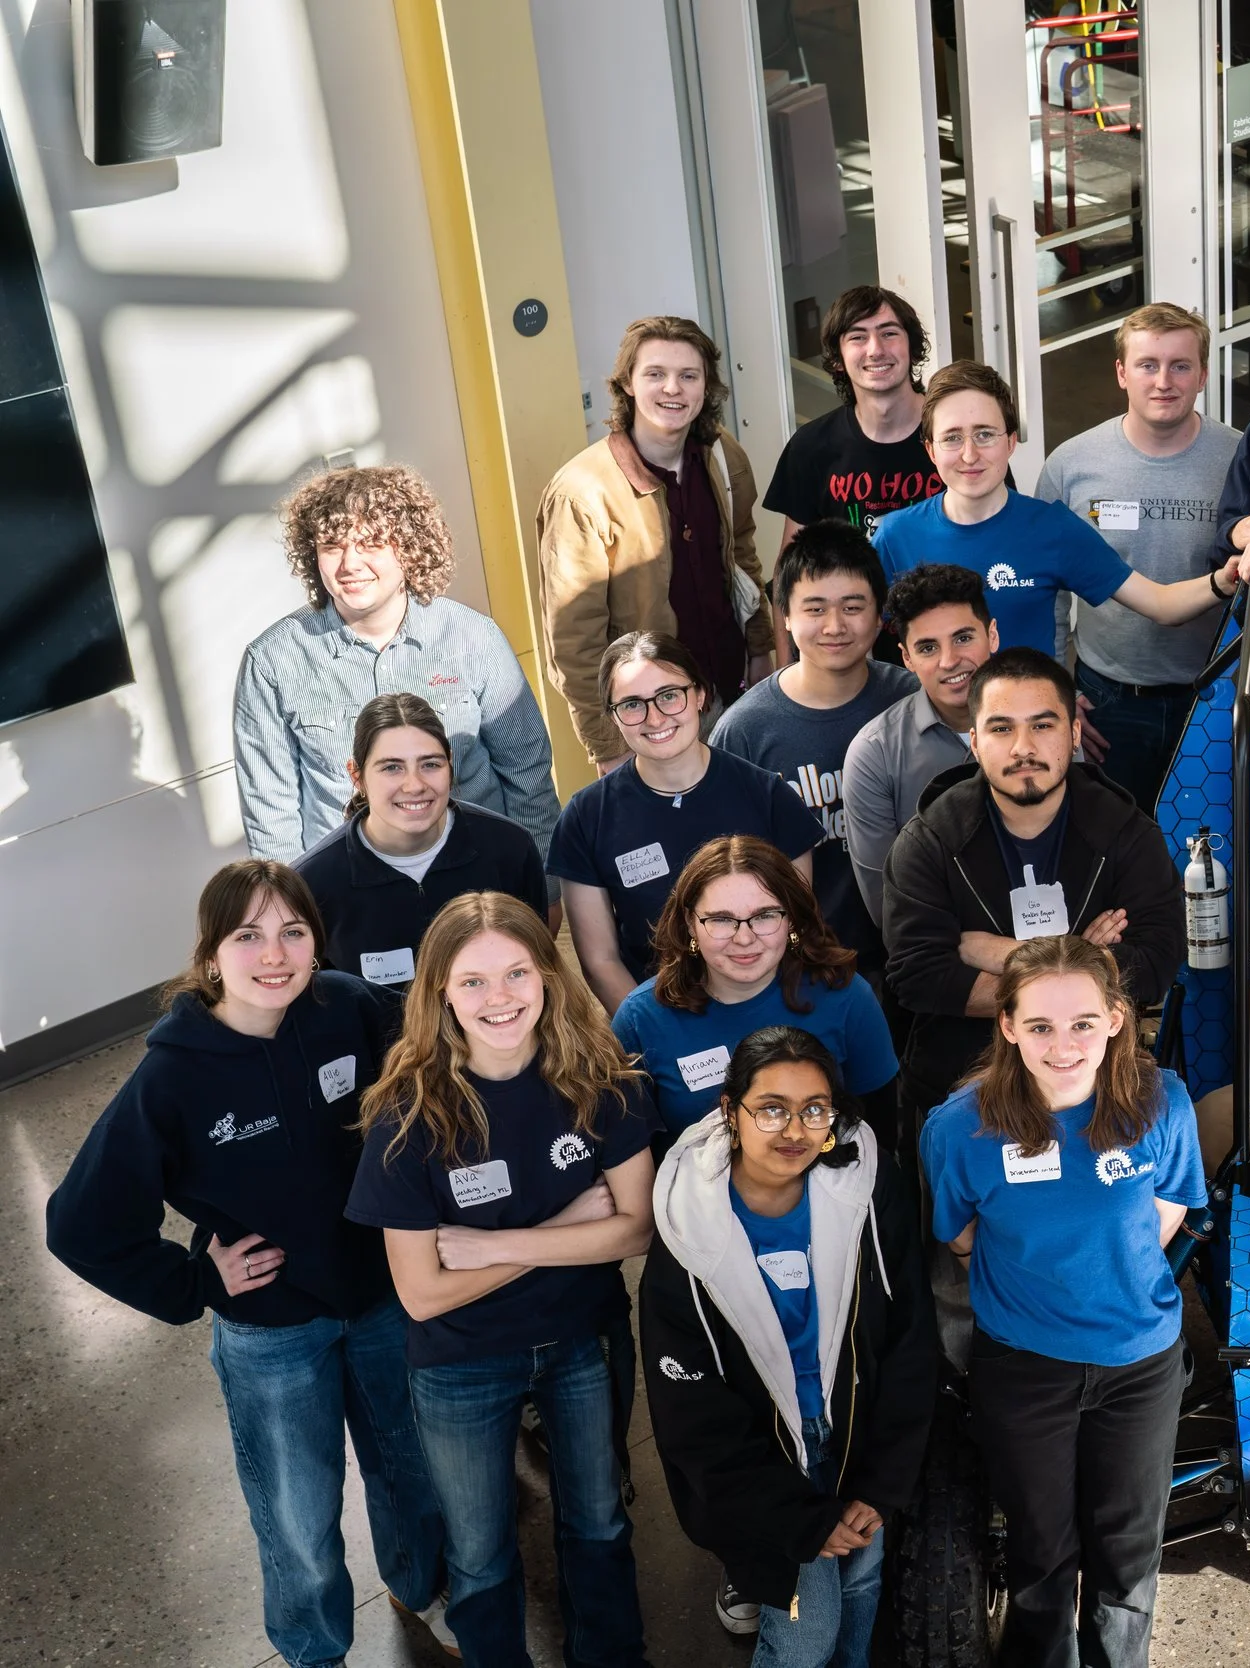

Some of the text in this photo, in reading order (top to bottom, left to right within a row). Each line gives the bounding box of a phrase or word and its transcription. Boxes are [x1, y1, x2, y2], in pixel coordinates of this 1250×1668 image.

[522, 304, 539, 316] 100
[829, 472, 943, 502] WO HOP
[1140, 498, 1205, 508] UNIVERSITY
[1139, 506, 1218, 523] OCHESTE
[996, 571, 1008, 580] UR
[998, 578, 1035, 587] BAJA SAE
[622, 848, 651, 865] ELLA
[680, 1057, 719, 1075] Miriam
[239, 1115, 277, 1133] UR Baja
[562, 1145, 576, 1156] UR
[566, 1149, 592, 1164] BAJA
[1107, 1160, 1122, 1171] UR
[1111, 1166, 1138, 1180] BAJA
